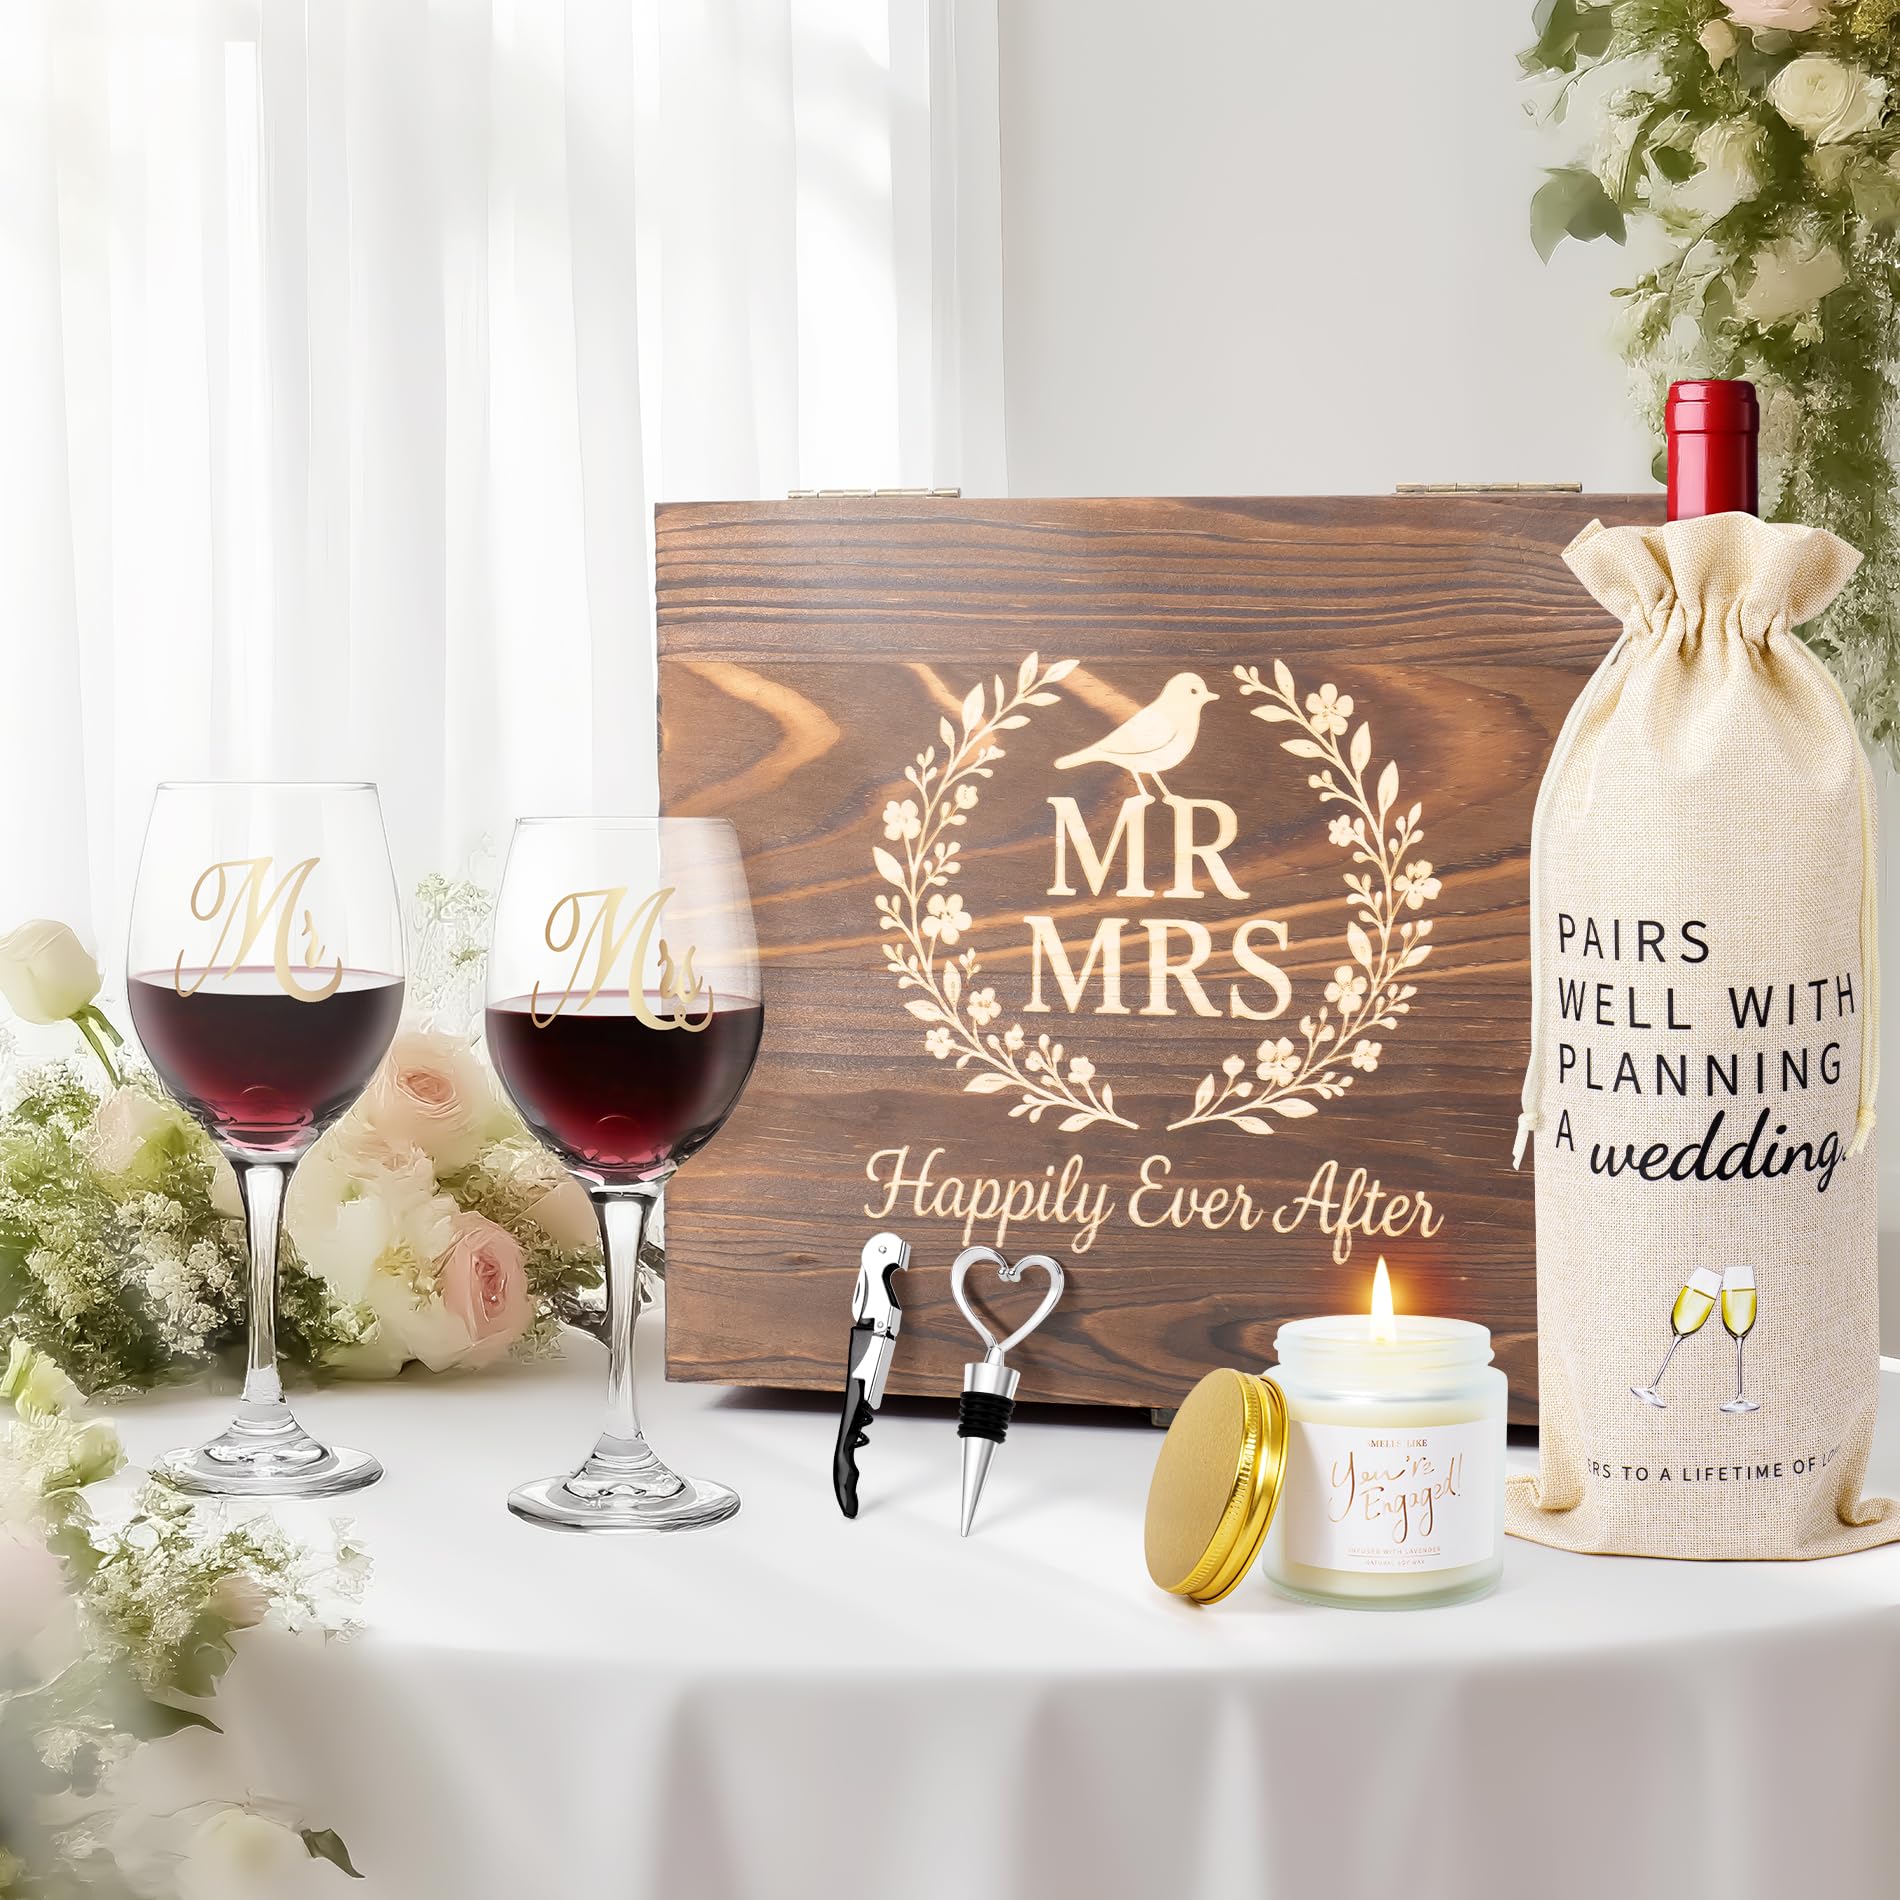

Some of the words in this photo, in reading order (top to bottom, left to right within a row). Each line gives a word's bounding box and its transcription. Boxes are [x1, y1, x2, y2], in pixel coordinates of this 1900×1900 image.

[1047, 796, 1250, 900] MR
[175, 857, 342, 1002] Mr
[531, 886, 714, 1032] Mrs
[1558, 913, 1709, 963] PAIRS
[1022, 915, 1293, 1020] MRS
[1558, 977, 1692, 1030] WELL
[1728, 973, 1855, 1029] WITH
[1559, 1042, 1841, 1096] PLANNING
[1556, 1109, 1575, 1151] A
[863, 1145, 1115, 1254] Happily
[1128, 1154, 1266, 1231] Ever
[1273, 1160, 1444, 1264] After
[1406, 1439, 1428, 1448] LIKE
[1621, 1466, 1649, 1481] TO
[1660, 1467, 1671, 1481] A
[1683, 1463, 1783, 1482] LIFETIME
[1793, 1457, 1816, 1474] OF
[1328, 1451, 1435, 1522] You're
[1361, 1453, 1463, 1543] Engaged!
